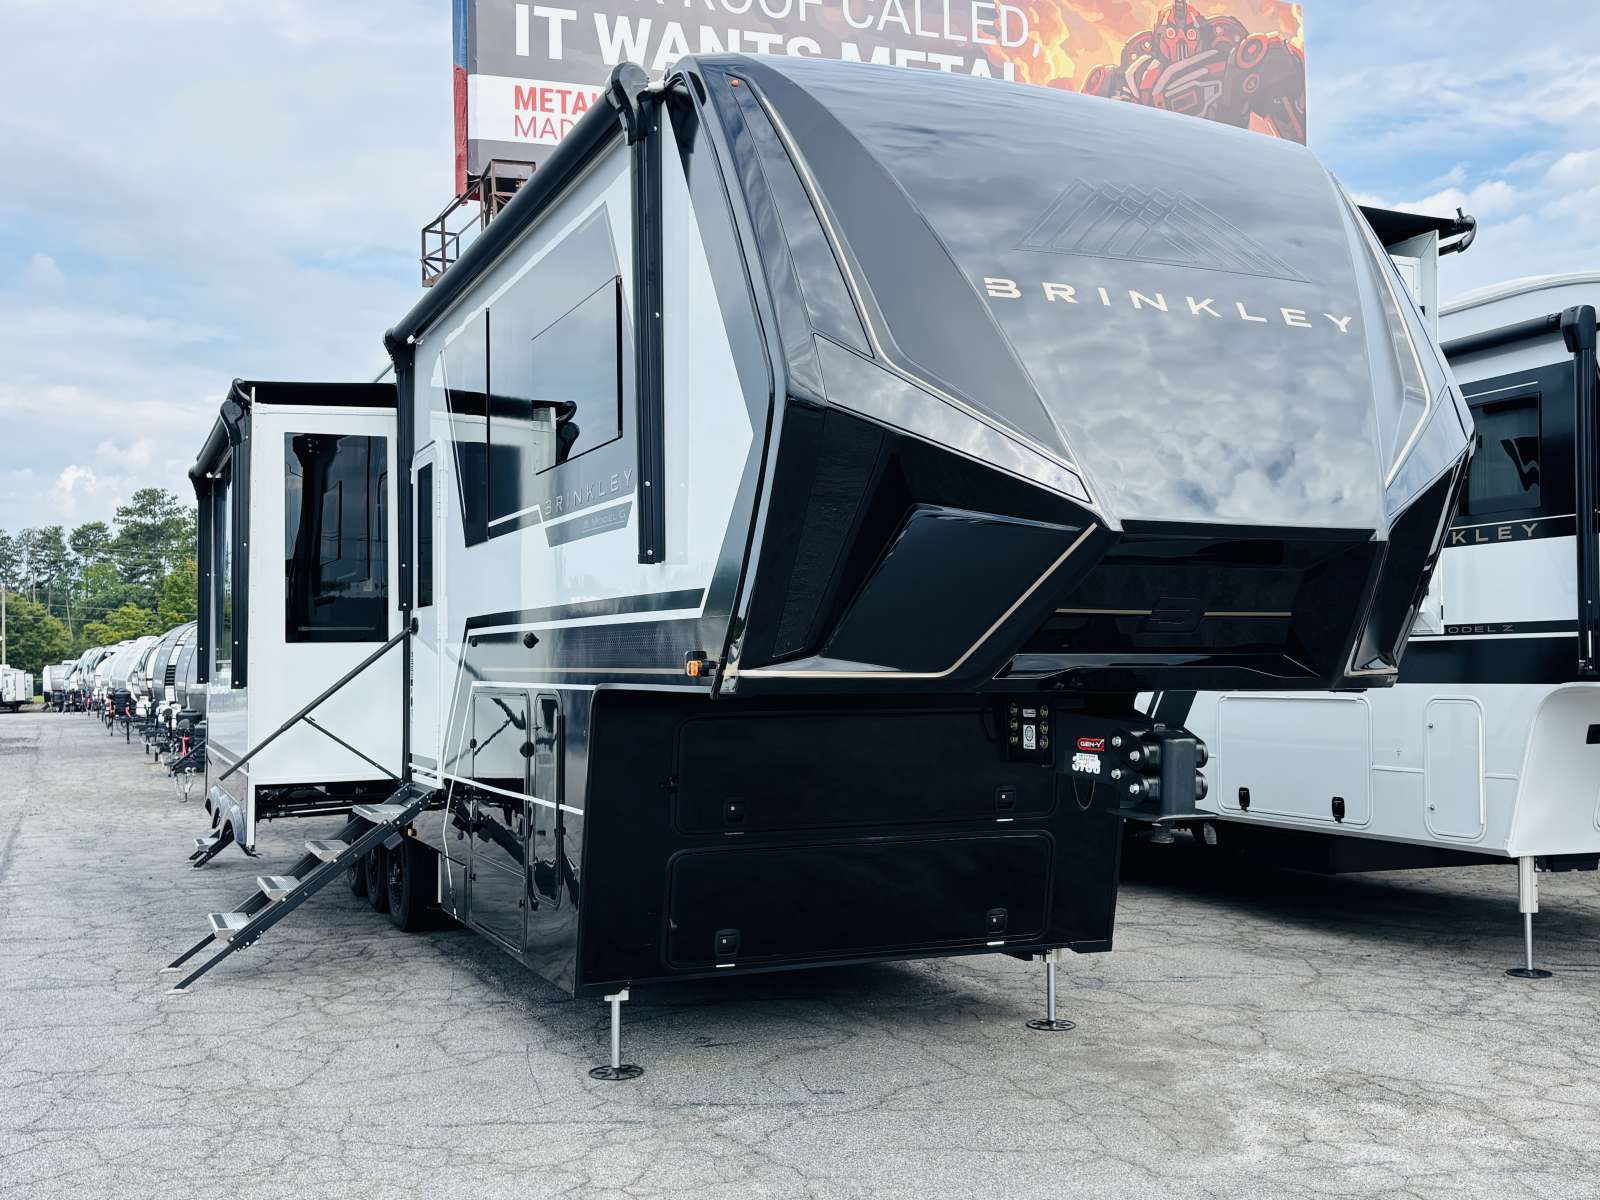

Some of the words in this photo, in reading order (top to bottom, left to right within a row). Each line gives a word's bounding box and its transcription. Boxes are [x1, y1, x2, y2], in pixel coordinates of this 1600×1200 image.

[515, 3, 577, 60] IT
[514, 85, 598, 116] META
[983, 277, 1353, 333] BRINKLEY
[543, 468, 633, 516] BRINKLEY
[1452, 522, 1539, 545] KLEY
[1502, 624, 1514, 633] Z
